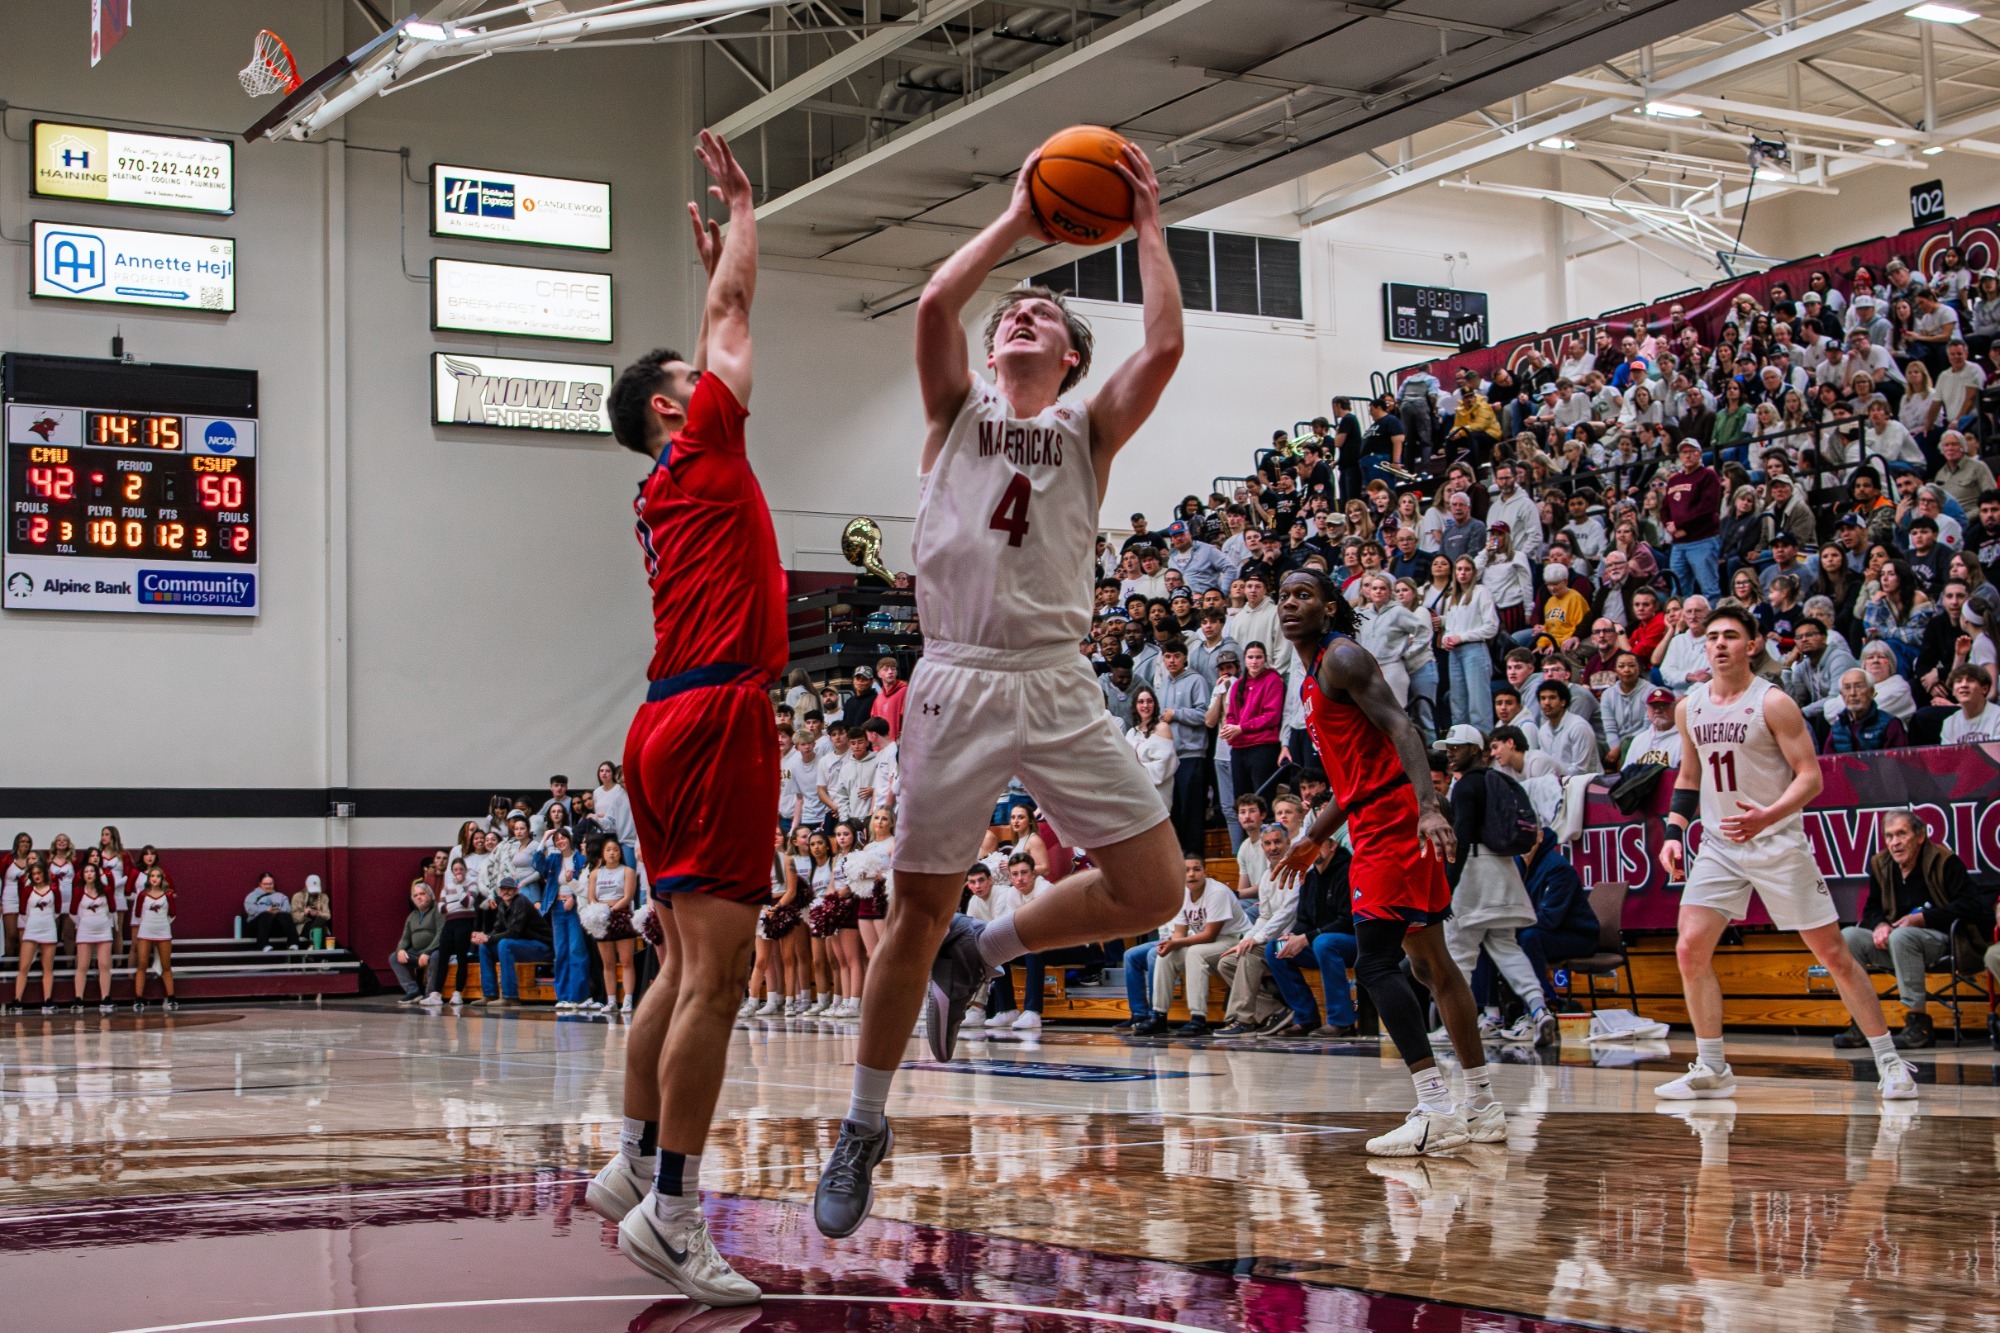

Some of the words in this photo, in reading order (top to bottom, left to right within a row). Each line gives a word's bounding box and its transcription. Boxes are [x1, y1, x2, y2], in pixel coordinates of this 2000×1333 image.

[40, 168, 107, 183] HAINING
[118, 157, 220, 179] 970-242-4429
[112, 173, 142, 181] HEATING
[152, 176, 181, 185] COOLING
[190, 180, 226, 189] PLUMBING
[482, 195, 514, 207] Express
[537, 199, 603, 213] CANDLEWOOD
[1912, 189, 1944, 218] 102
[114, 253, 191, 272] Annette
[197, 260, 231, 279] Hejl
[114, 272, 193, 287] PROPERTIES
[535, 280, 600, 303] CAFE
[448, 296, 537, 314] BREAKFAST
[553, 307, 600, 320] LUNCH
[1458, 322, 1479, 344] 101
[453, 374, 604, 424] KNOWLES
[486, 407, 601, 431] ENTERPRISES
[99, 415, 180, 449] 14:15
[208, 436, 236, 446] NCAA
[31, 447, 68, 463] CMU
[979, 421, 1063, 467] MAERICKS
[117, 460, 152, 472] PERIOD
[193, 457, 238, 473] CSUP
[30, 468, 74, 499] 42
[126, 475, 142, 500] 2
[201, 476, 242, 507] 50
[16, 502, 49, 514] FOULS
[88, 505, 113, 517] PLYR
[122, 507, 147, 518] FOUL
[159, 509, 178, 520] PTS
[218, 512, 250, 523] FOULS
[989, 472, 1032, 548] 4
[31, 517, 48, 543] 2
[60, 521, 73, 541] 3
[91, 521, 117, 546] 10
[126, 522, 142, 547] 0
[160, 524, 184, 549] 12
[195, 528, 207, 547] 3
[233, 526, 249, 552] 2
[57, 544, 76, 553] T.O.L.
[192, 550, 211, 559] T.O.L.
[43, 579, 91, 595] Alpine
[95, 580, 132, 594] Bank
[144, 574, 250, 598] Community
[183, 593, 241, 604] HOSPITAL
[1693, 722, 1748, 747] MAVERICKS
[1708, 750, 1738, 792] 11
[1557, 822, 1650, 890] HIS
